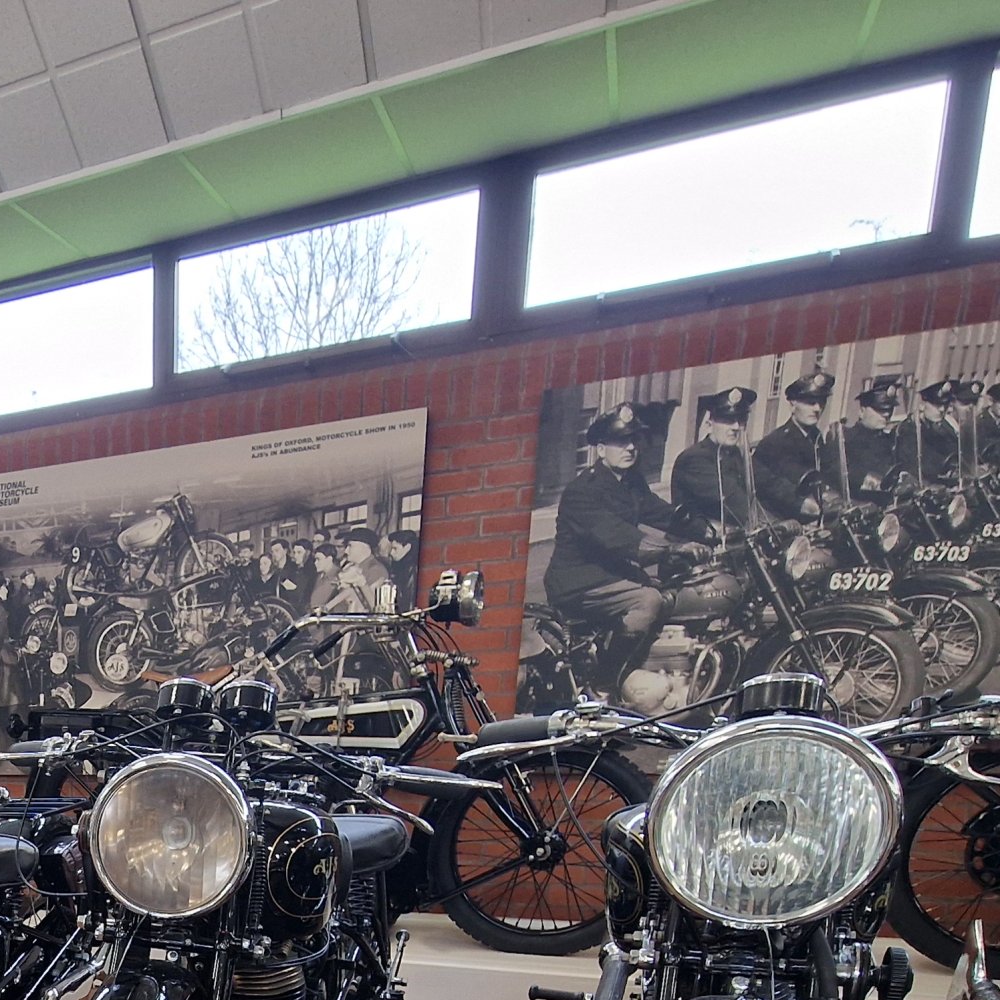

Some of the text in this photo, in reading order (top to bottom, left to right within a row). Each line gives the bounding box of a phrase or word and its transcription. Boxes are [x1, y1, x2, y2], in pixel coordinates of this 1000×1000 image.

[251, 443, 272, 451] KINGS
[284, 437, 314, 447] OXFORD,
[315, 429, 363, 443] MOTORCYCLE
[365, 426, 386, 435] SHOW
[398, 421, 416, 430] 1950
[279, 443, 321, 455] ABUNDANCE
[71, 546, 81, 564] 9
[327, 719, 355, 734] AS
